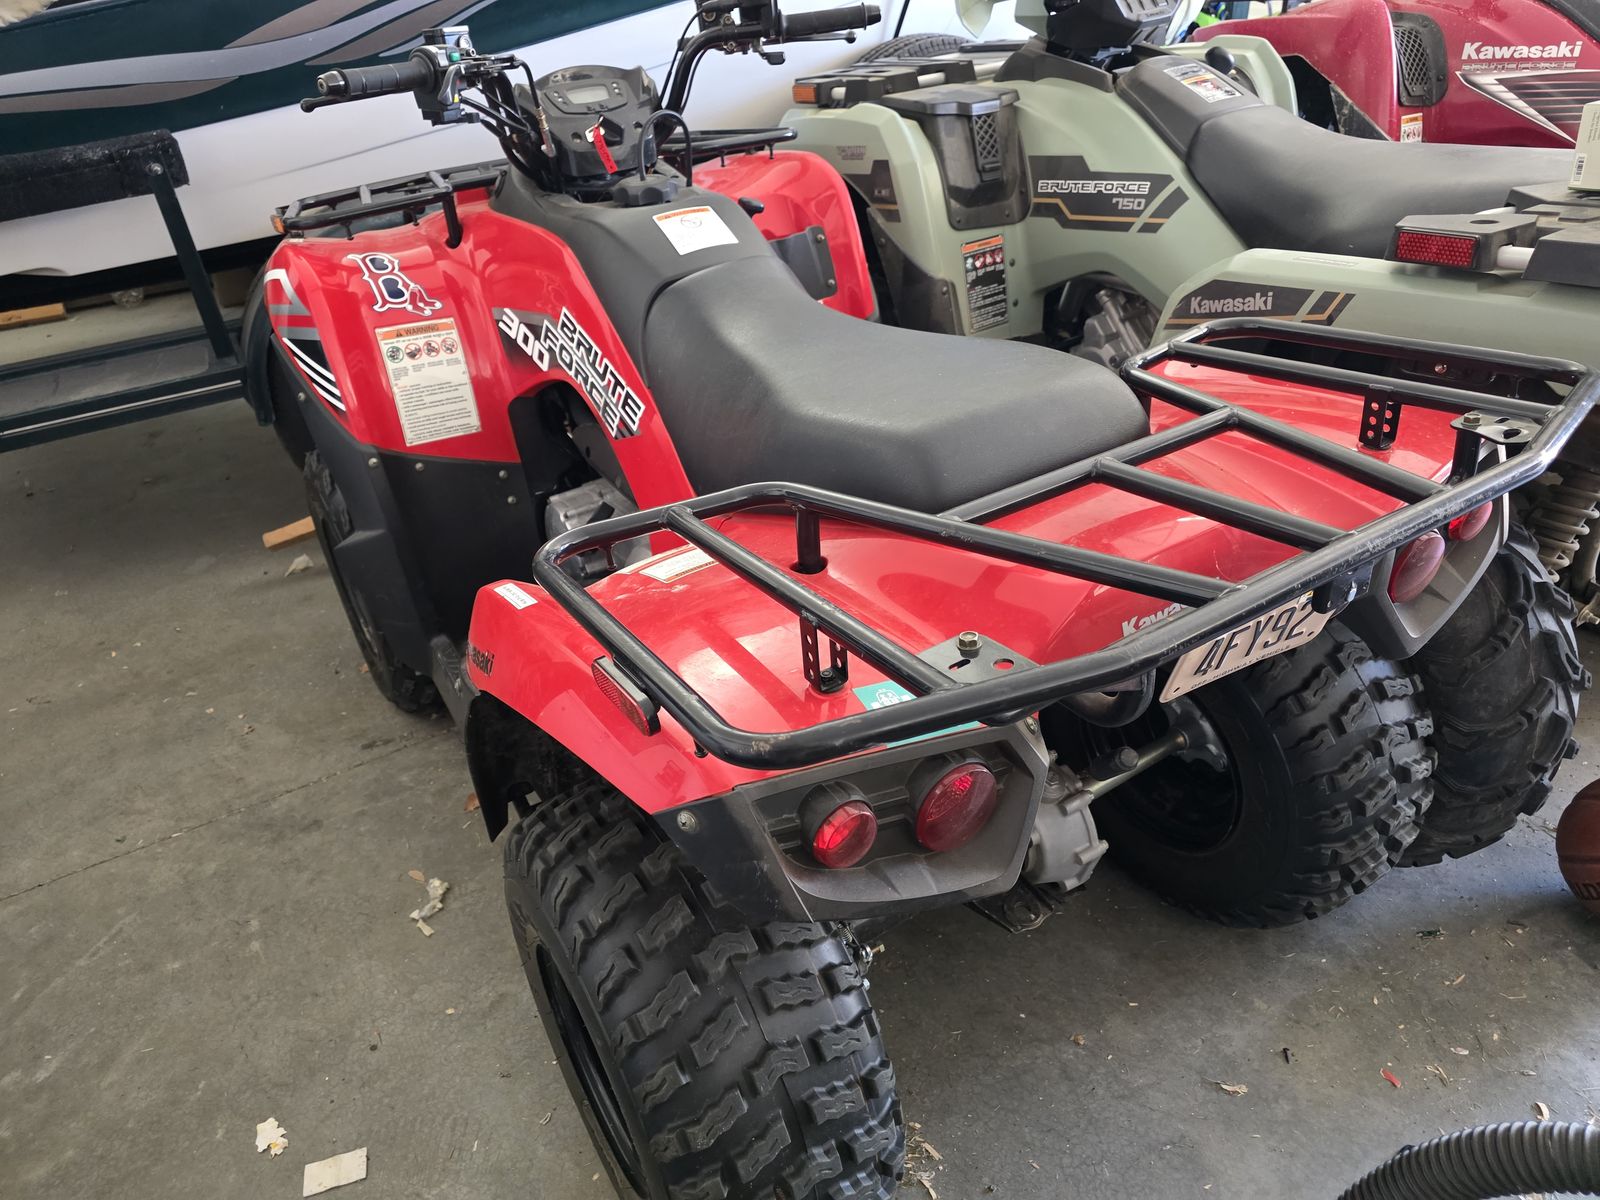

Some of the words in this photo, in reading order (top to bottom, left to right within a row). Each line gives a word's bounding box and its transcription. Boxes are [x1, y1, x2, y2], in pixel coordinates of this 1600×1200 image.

[1461, 41, 1583, 60] Kawasaki
[1112, 197, 1146, 210] 750
[1190, 292, 1274, 314] Kawasaki
[404, 324, 440, 336] WARNING
[498, 308, 550, 372] 300
[541, 319, 620, 438] FORCE
[557, 306, 645, 432] BRUTE
